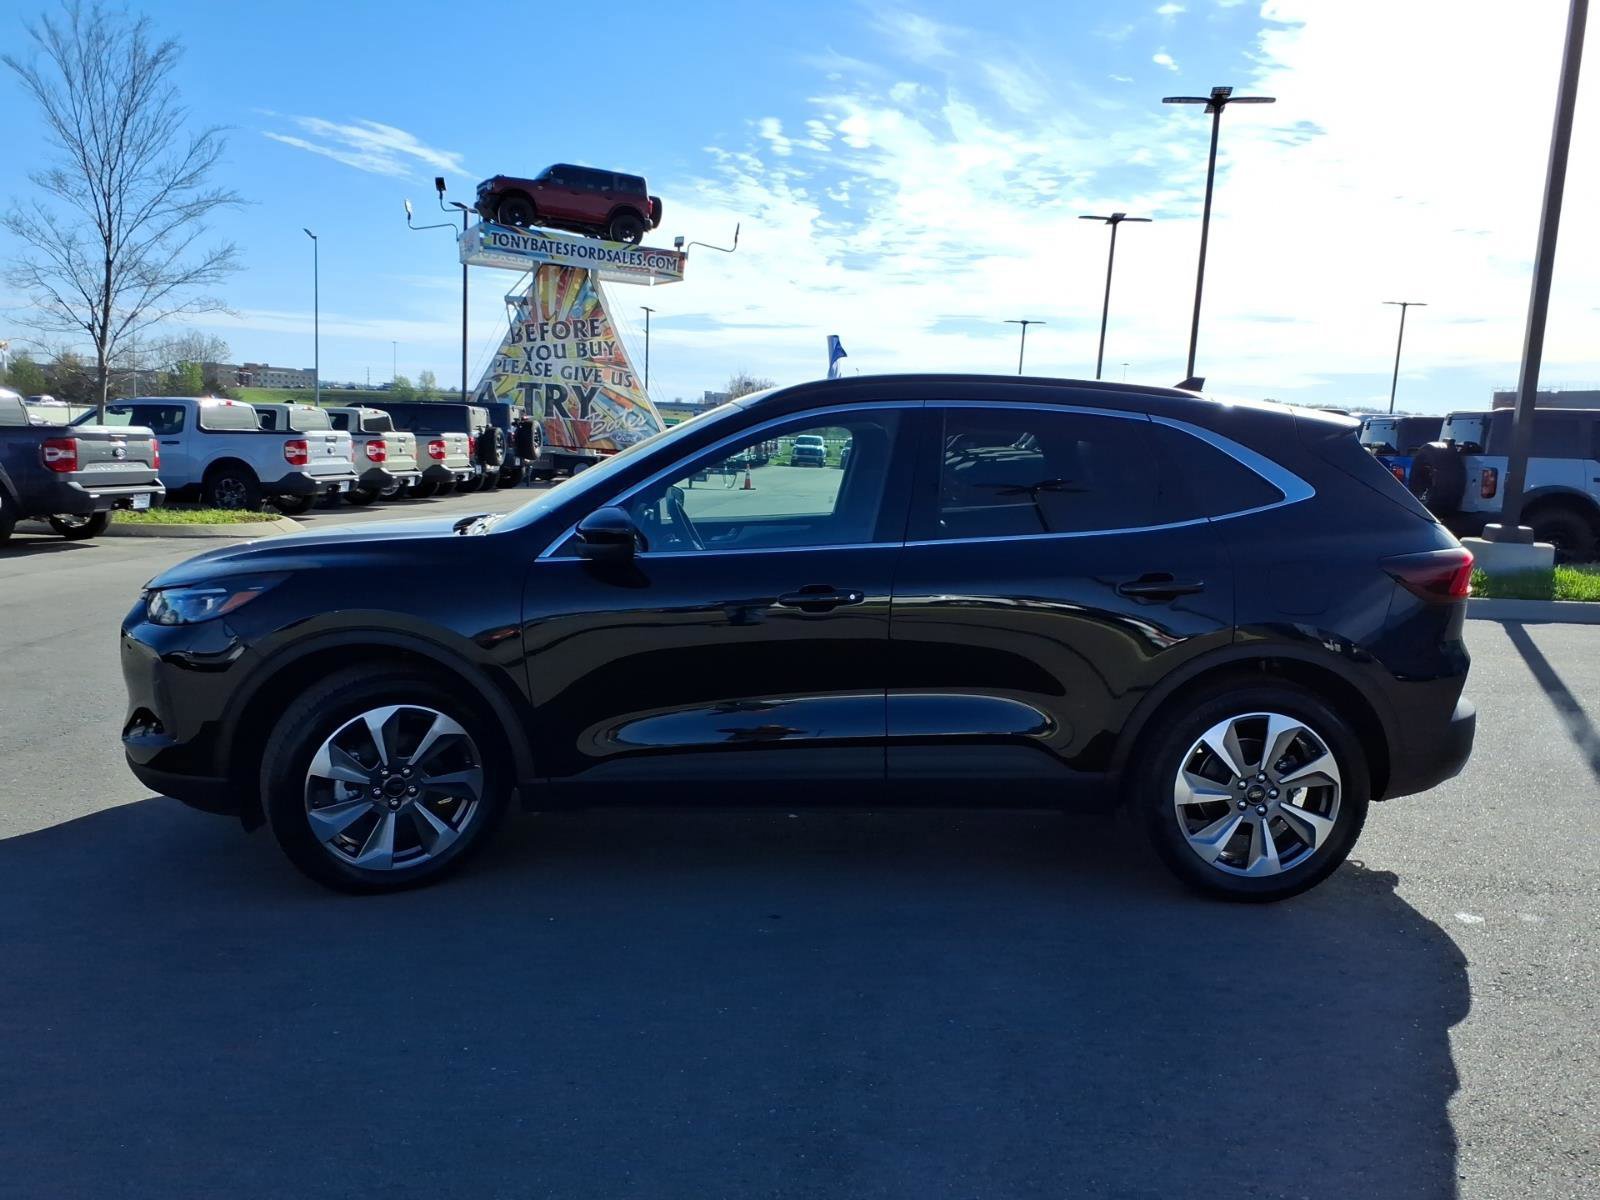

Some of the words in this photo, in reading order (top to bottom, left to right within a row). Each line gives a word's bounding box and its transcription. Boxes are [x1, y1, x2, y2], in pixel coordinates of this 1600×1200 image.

[491, 232, 678, 270] TONYBATESFORDSALES.COM
[511, 319, 601, 344] BEFORE
[523, 343, 567, 361] YOU
[576, 341, 616, 358] BUY
[493, 358, 553, 377] PLEASE
[561, 366, 603, 384] GIVE
[611, 372, 632, 387] US
[477, 381, 497, 403] A
[516, 382, 600, 419] TRY
